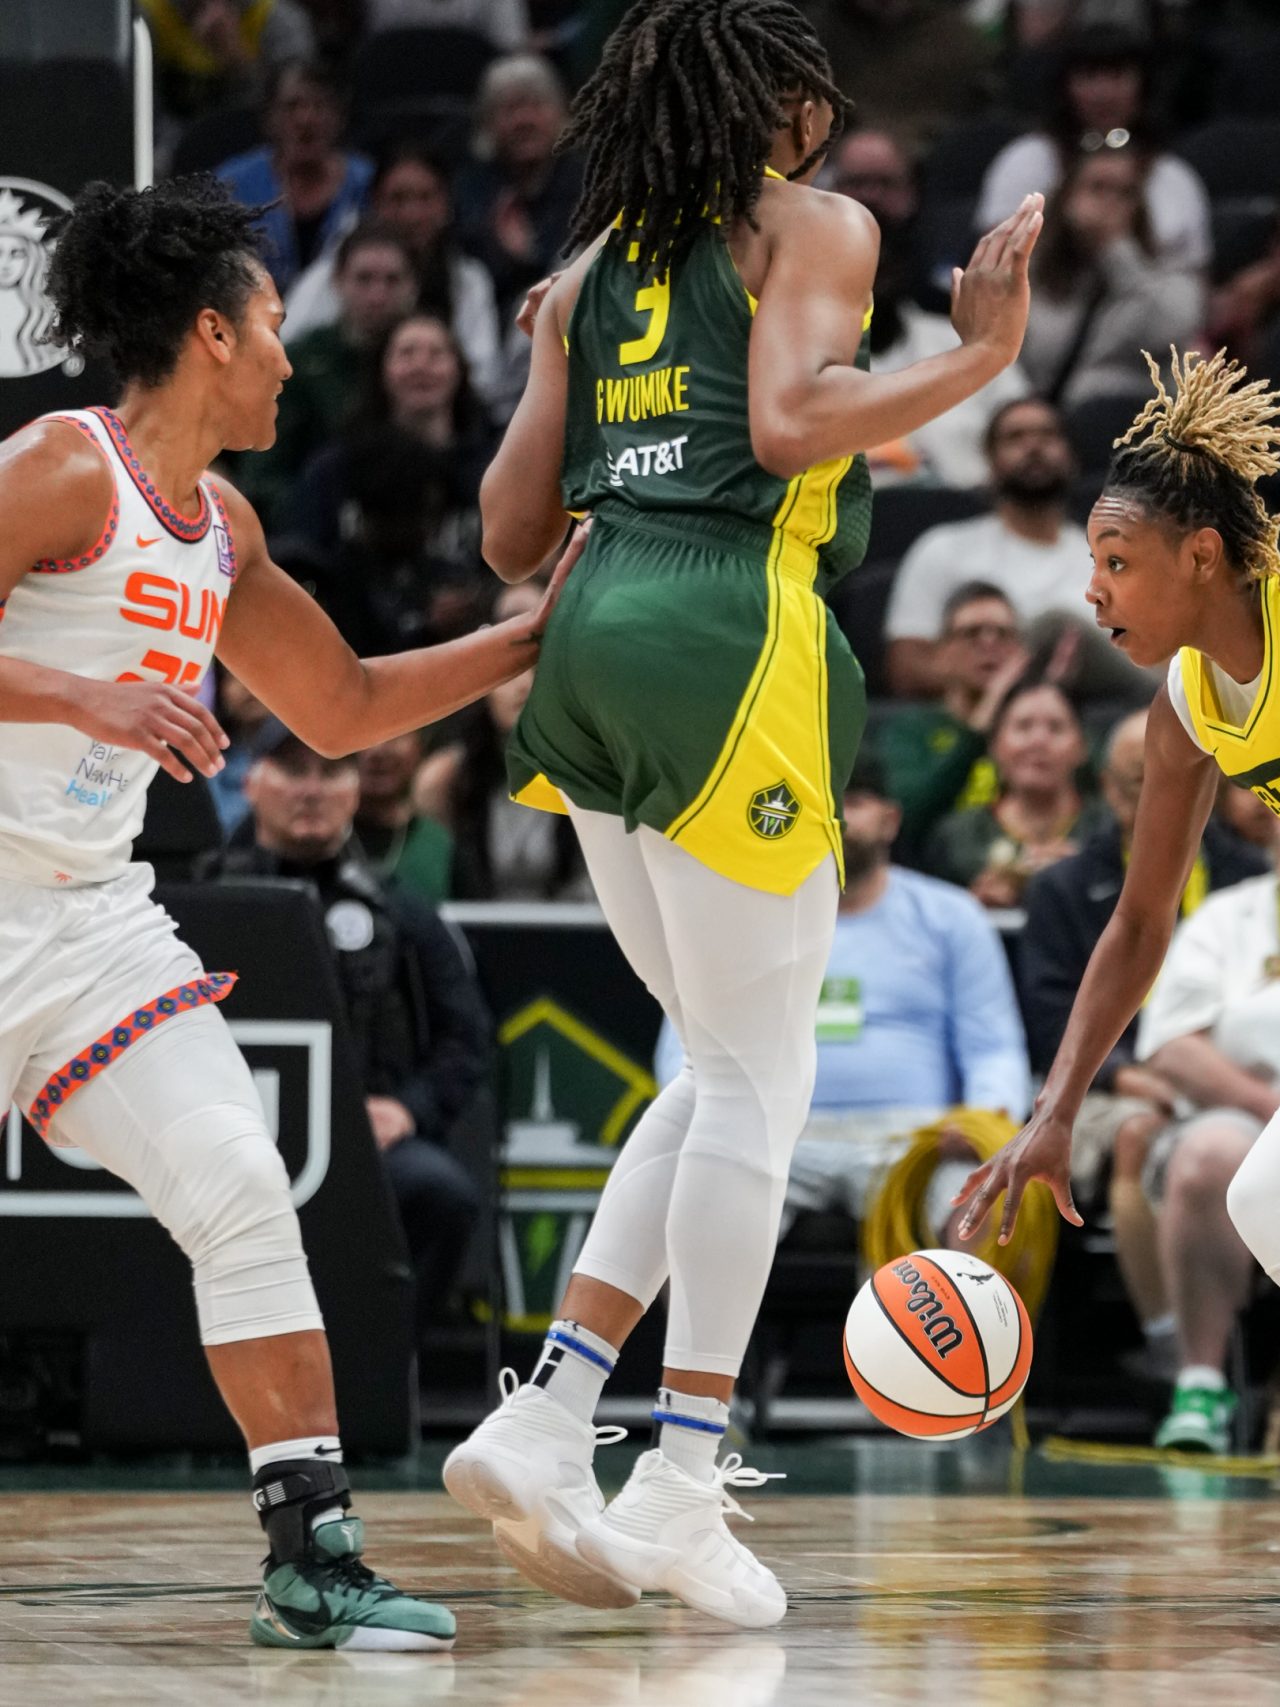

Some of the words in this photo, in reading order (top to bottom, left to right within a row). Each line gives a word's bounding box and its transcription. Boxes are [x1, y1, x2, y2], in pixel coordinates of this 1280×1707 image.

[614, 434, 689, 477] AT&T
[119, 571, 228, 643] SUN
[65, 779, 113, 808] Heal
[891, 1259, 963, 1361] Wilson
